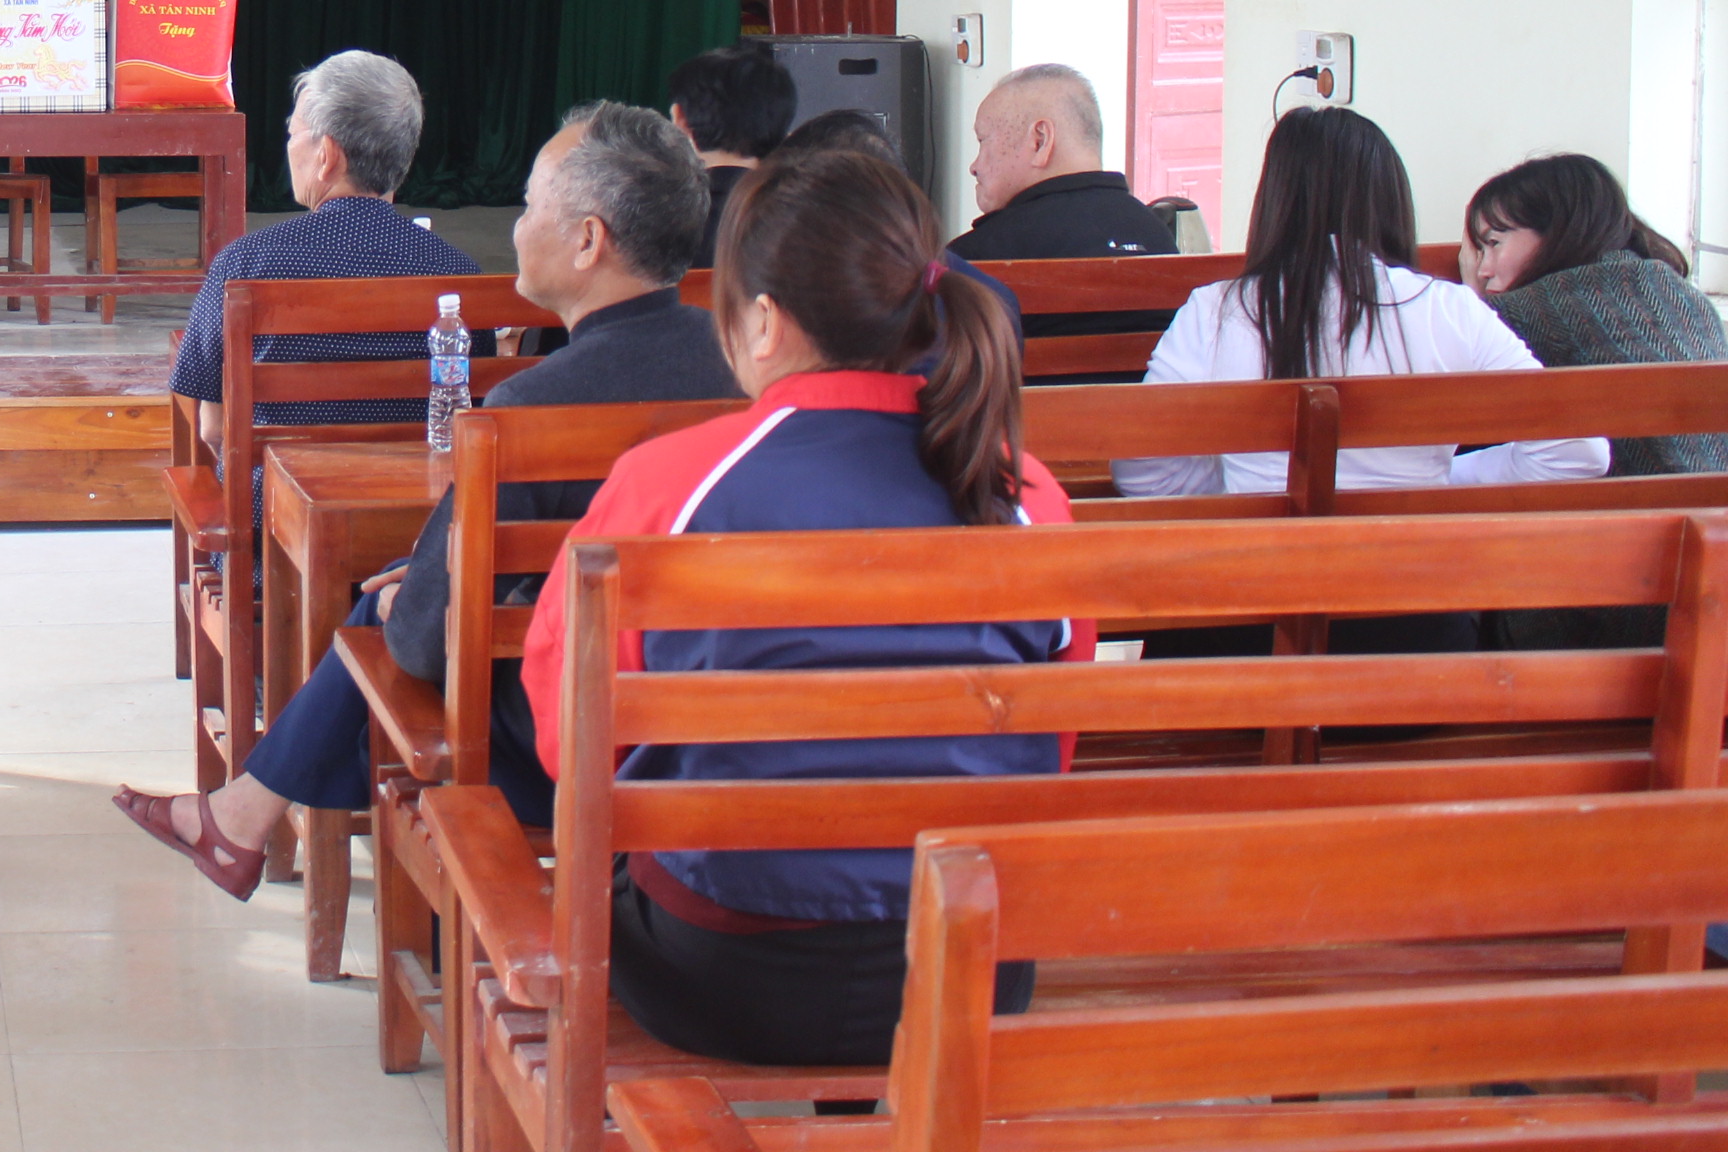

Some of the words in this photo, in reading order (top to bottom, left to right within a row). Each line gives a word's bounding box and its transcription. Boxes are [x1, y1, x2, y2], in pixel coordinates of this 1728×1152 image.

[139, 3, 156, 14] XÃ
[158, 3, 183, 15] TÂN
[185, 6, 216, 15] NINH
[158, 22, 196, 38] Tặng
